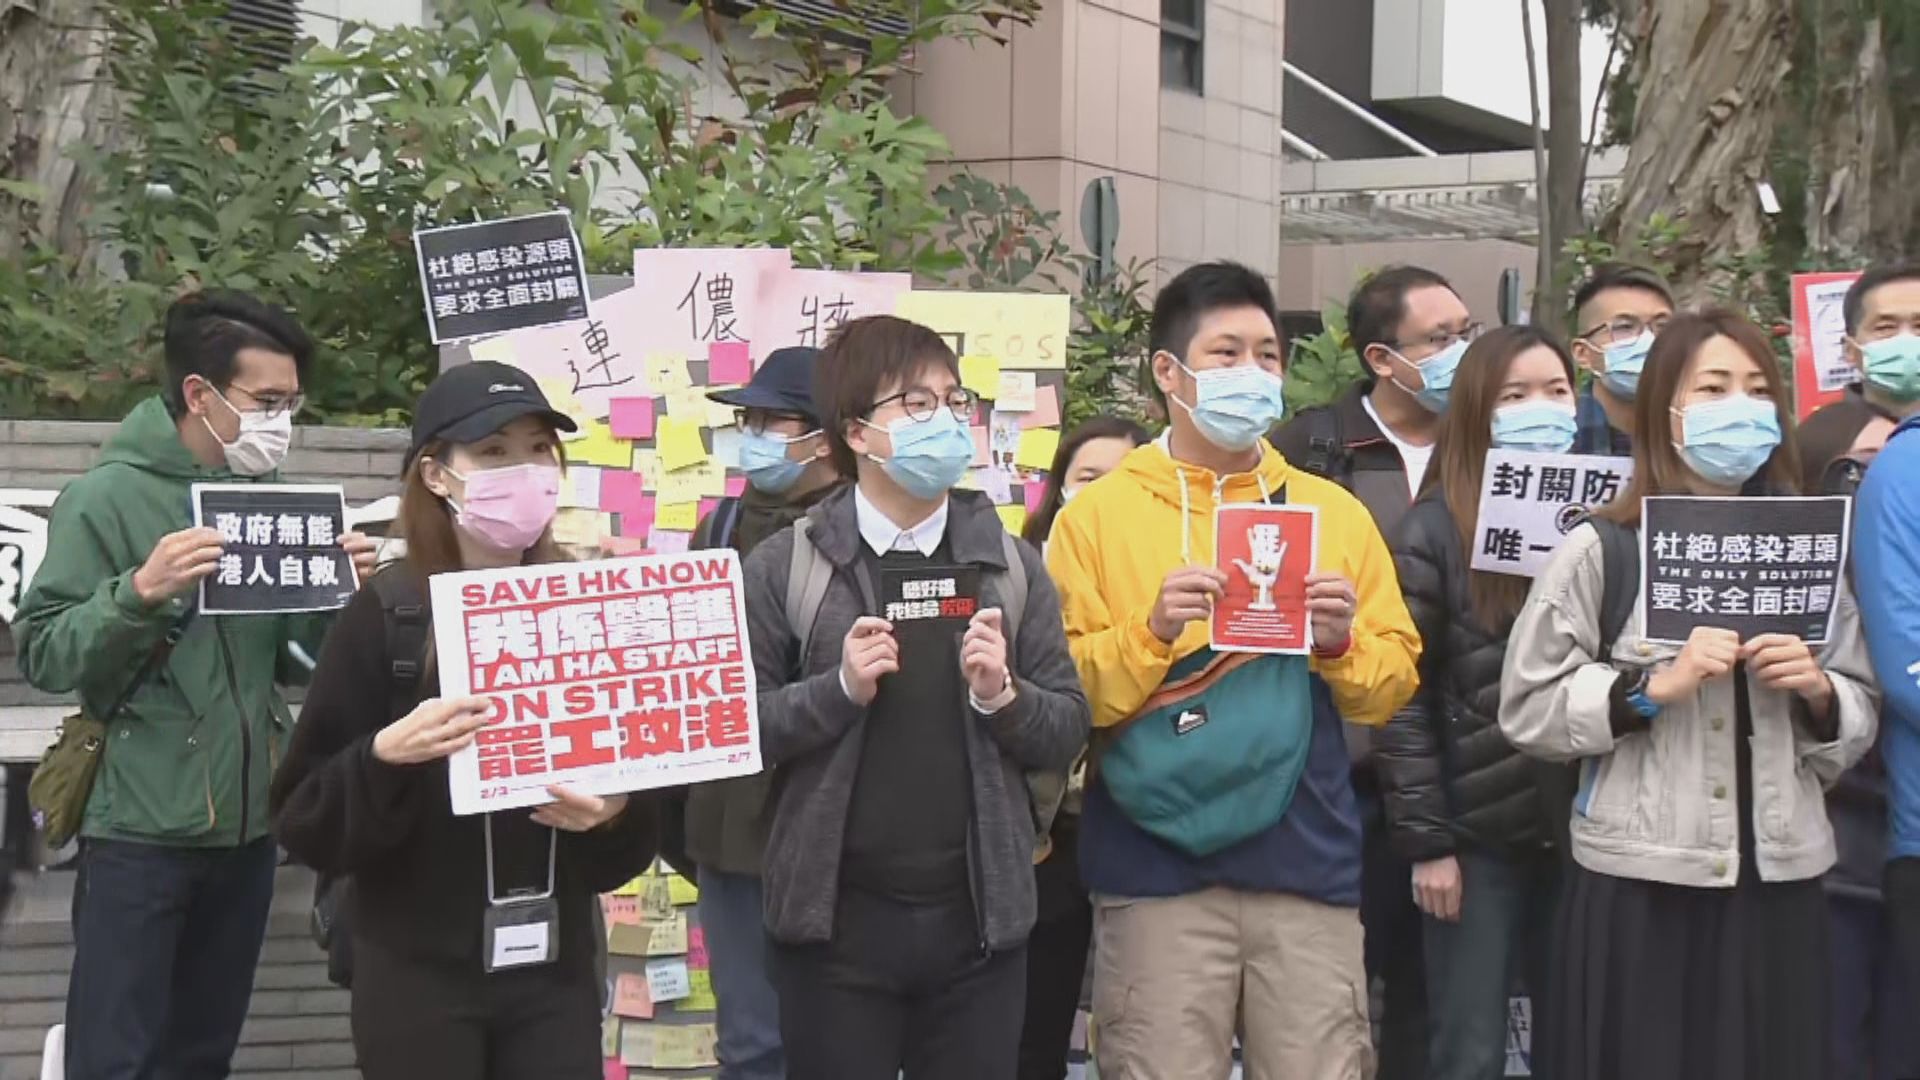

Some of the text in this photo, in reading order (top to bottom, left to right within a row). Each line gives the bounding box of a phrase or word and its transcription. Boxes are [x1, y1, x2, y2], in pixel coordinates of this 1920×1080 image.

[428, 238, 573, 279] 杜絕感染源頭
[436, 264, 573, 292] THE ONLY SOLUTION
[433, 276, 580, 318] 要求全面封關
[974, 334, 1054, 360] SOS
[1491, 462, 1630, 503] 封關防
[215, 512, 334, 545] 政府無能
[1482, 528, 1555, 561] 唯一
[1652, 531, 1840, 563] 杜絕感染源頭
[217, 553, 339, 586] 港人自救
[461, 558, 730, 607] SAVE HK NOW
[1658, 566, 1834, 581] THE ONLY SOLUTION
[1652, 582, 1833, 616] 要求全面封關
[466, 586, 740, 666] 我係醫護
[472, 635, 739, 690] I AM HA STAFF
[486, 666, 746, 724] ON STRIKE
[475, 697, 750, 781] 罷工救港
[727, 751, 751, 763] 2/7
